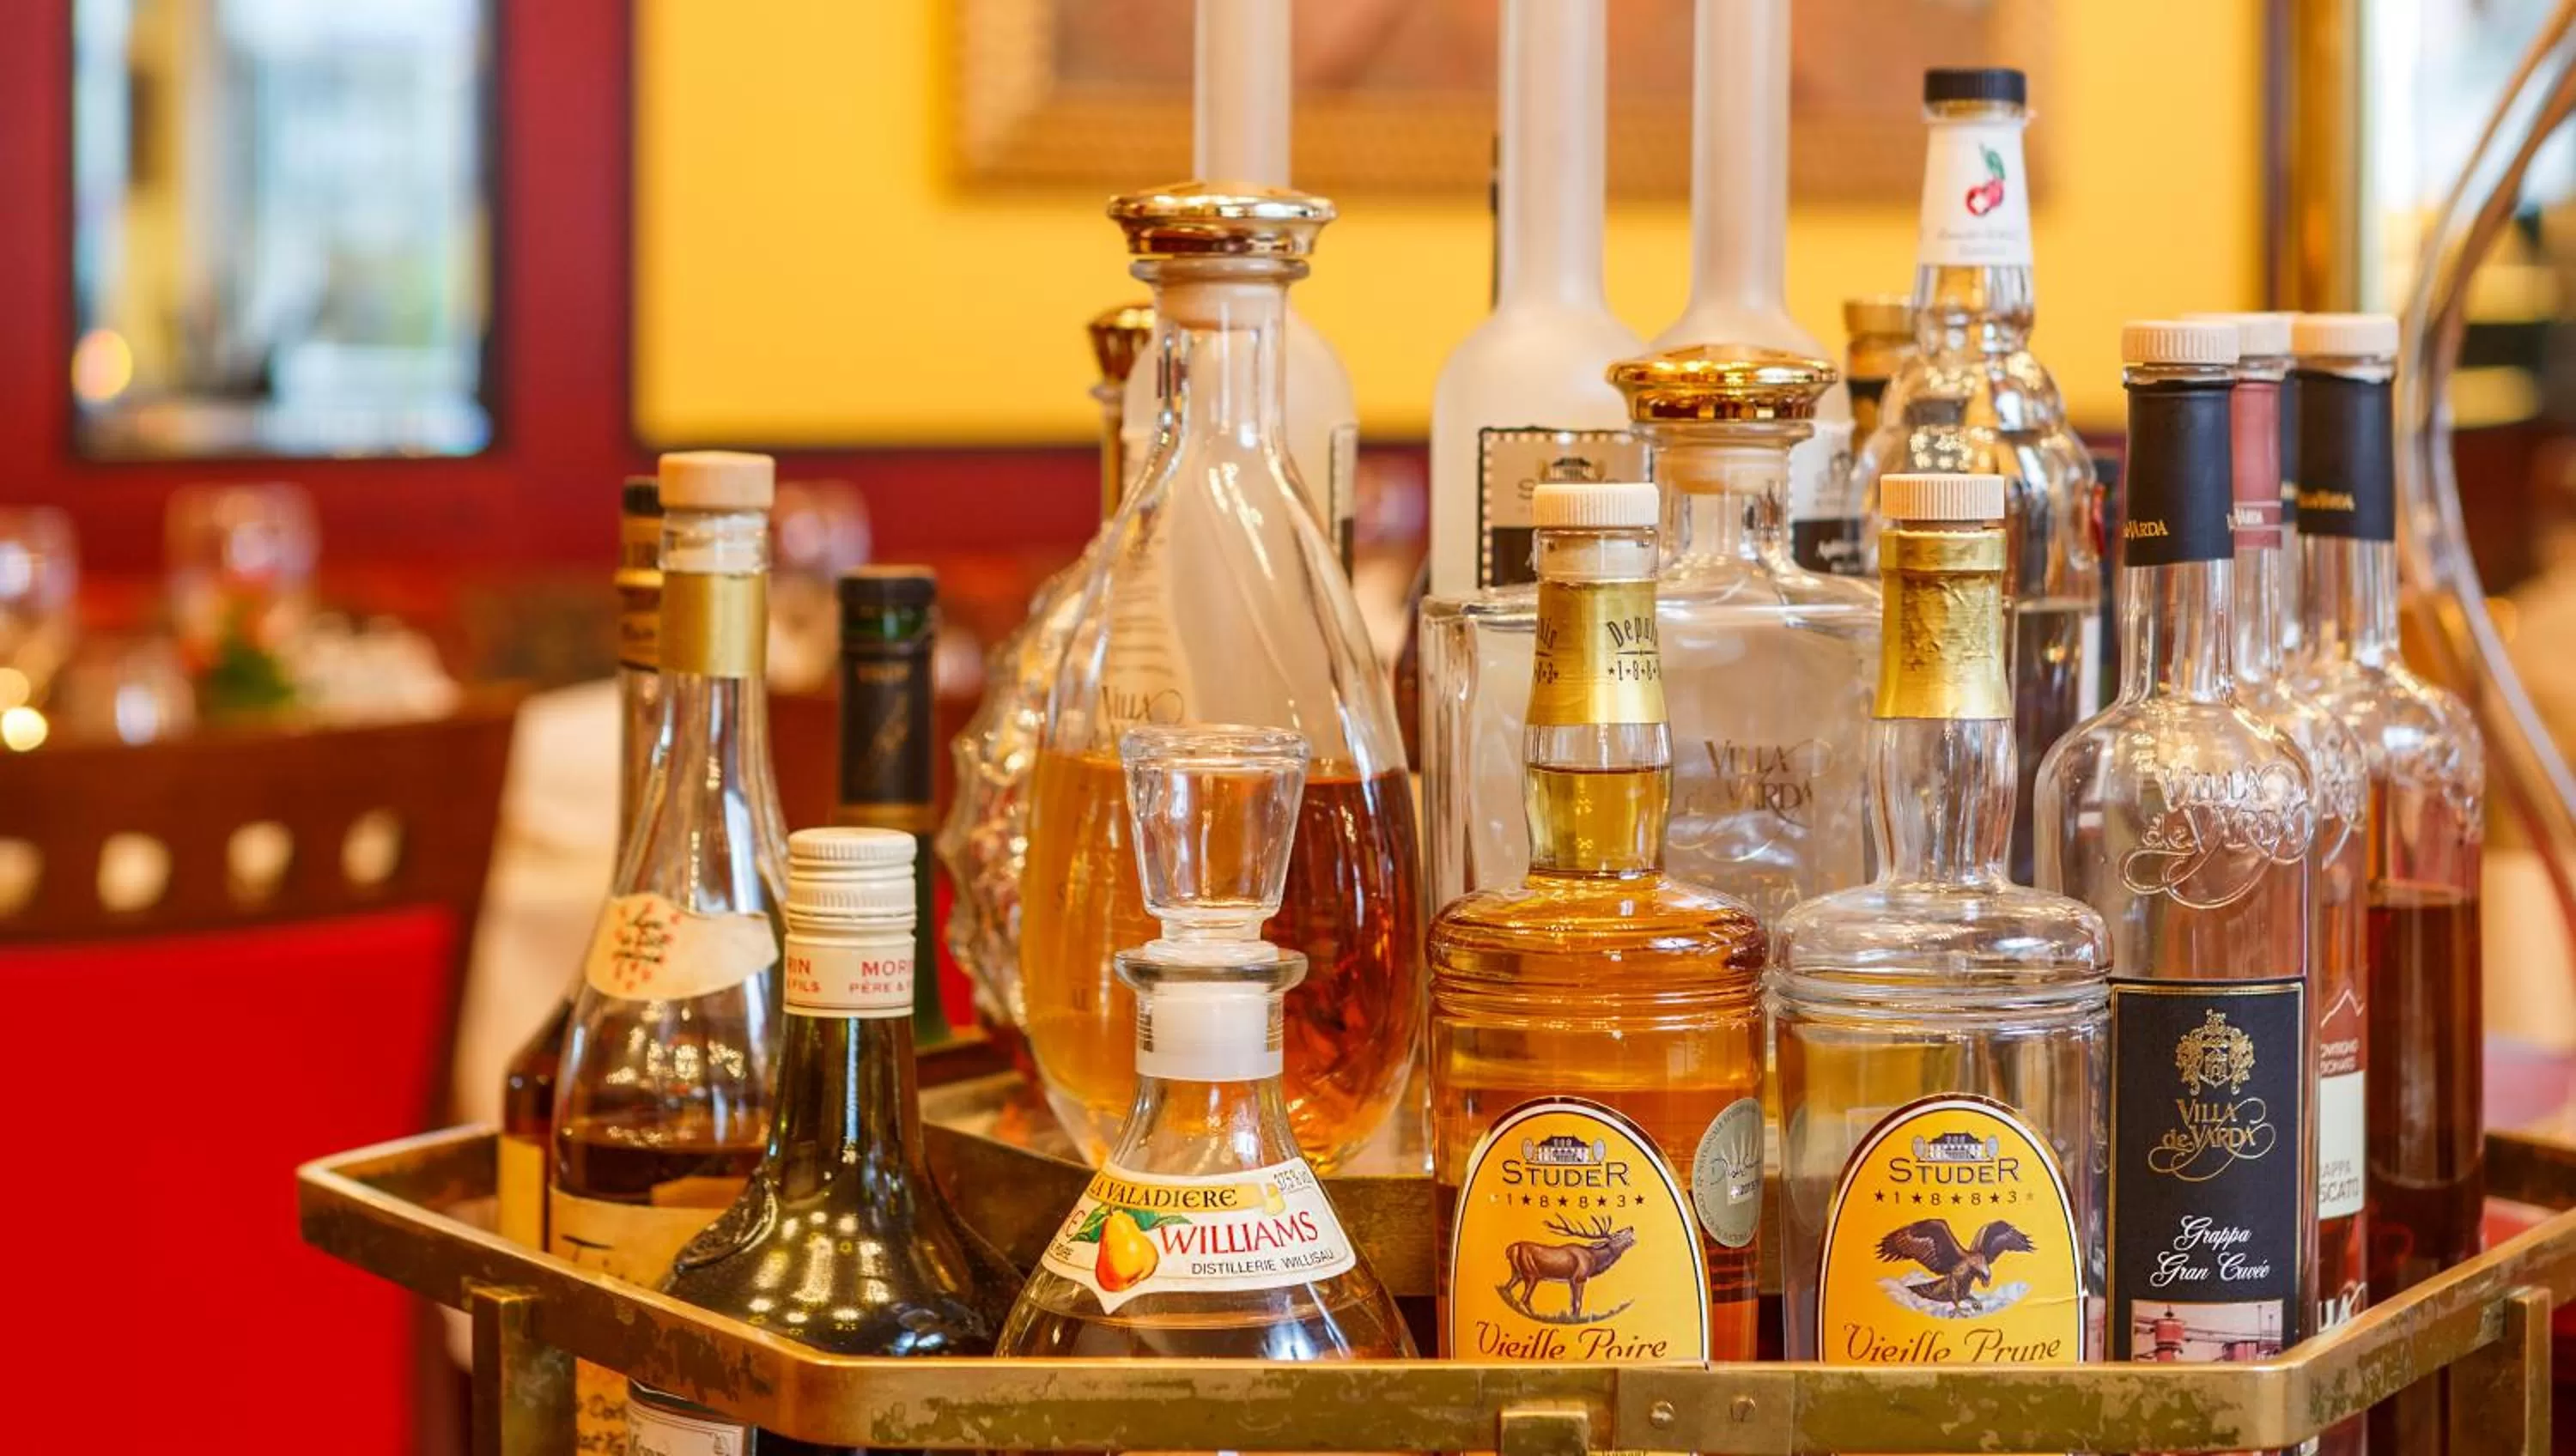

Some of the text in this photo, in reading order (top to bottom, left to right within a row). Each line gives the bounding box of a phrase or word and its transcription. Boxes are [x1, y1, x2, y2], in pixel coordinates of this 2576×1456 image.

[787, 955, 811, 974] RIN
[2176, 1098, 2238, 1129] VILLA
[1502, 1160, 1629, 1188] STUDER
[1889, 1157, 2020, 1185] STUDER
[2321, 1160, 2350, 1178] APPA
[2320, 1177, 2360, 1203] SCATO
[1160, 1210, 1318, 1255] WILLIAMS
[2173, 1215, 2252, 1251] Grappa
[1191, 1248, 1334, 1275] DISTILLERIE WILLISAU
[2149, 1251, 2271, 1288] Gran Cuvée
[1476, 1320, 1668, 1360] Vieille Poire
[1844, 1322, 2062, 1363] Vieille Prune
